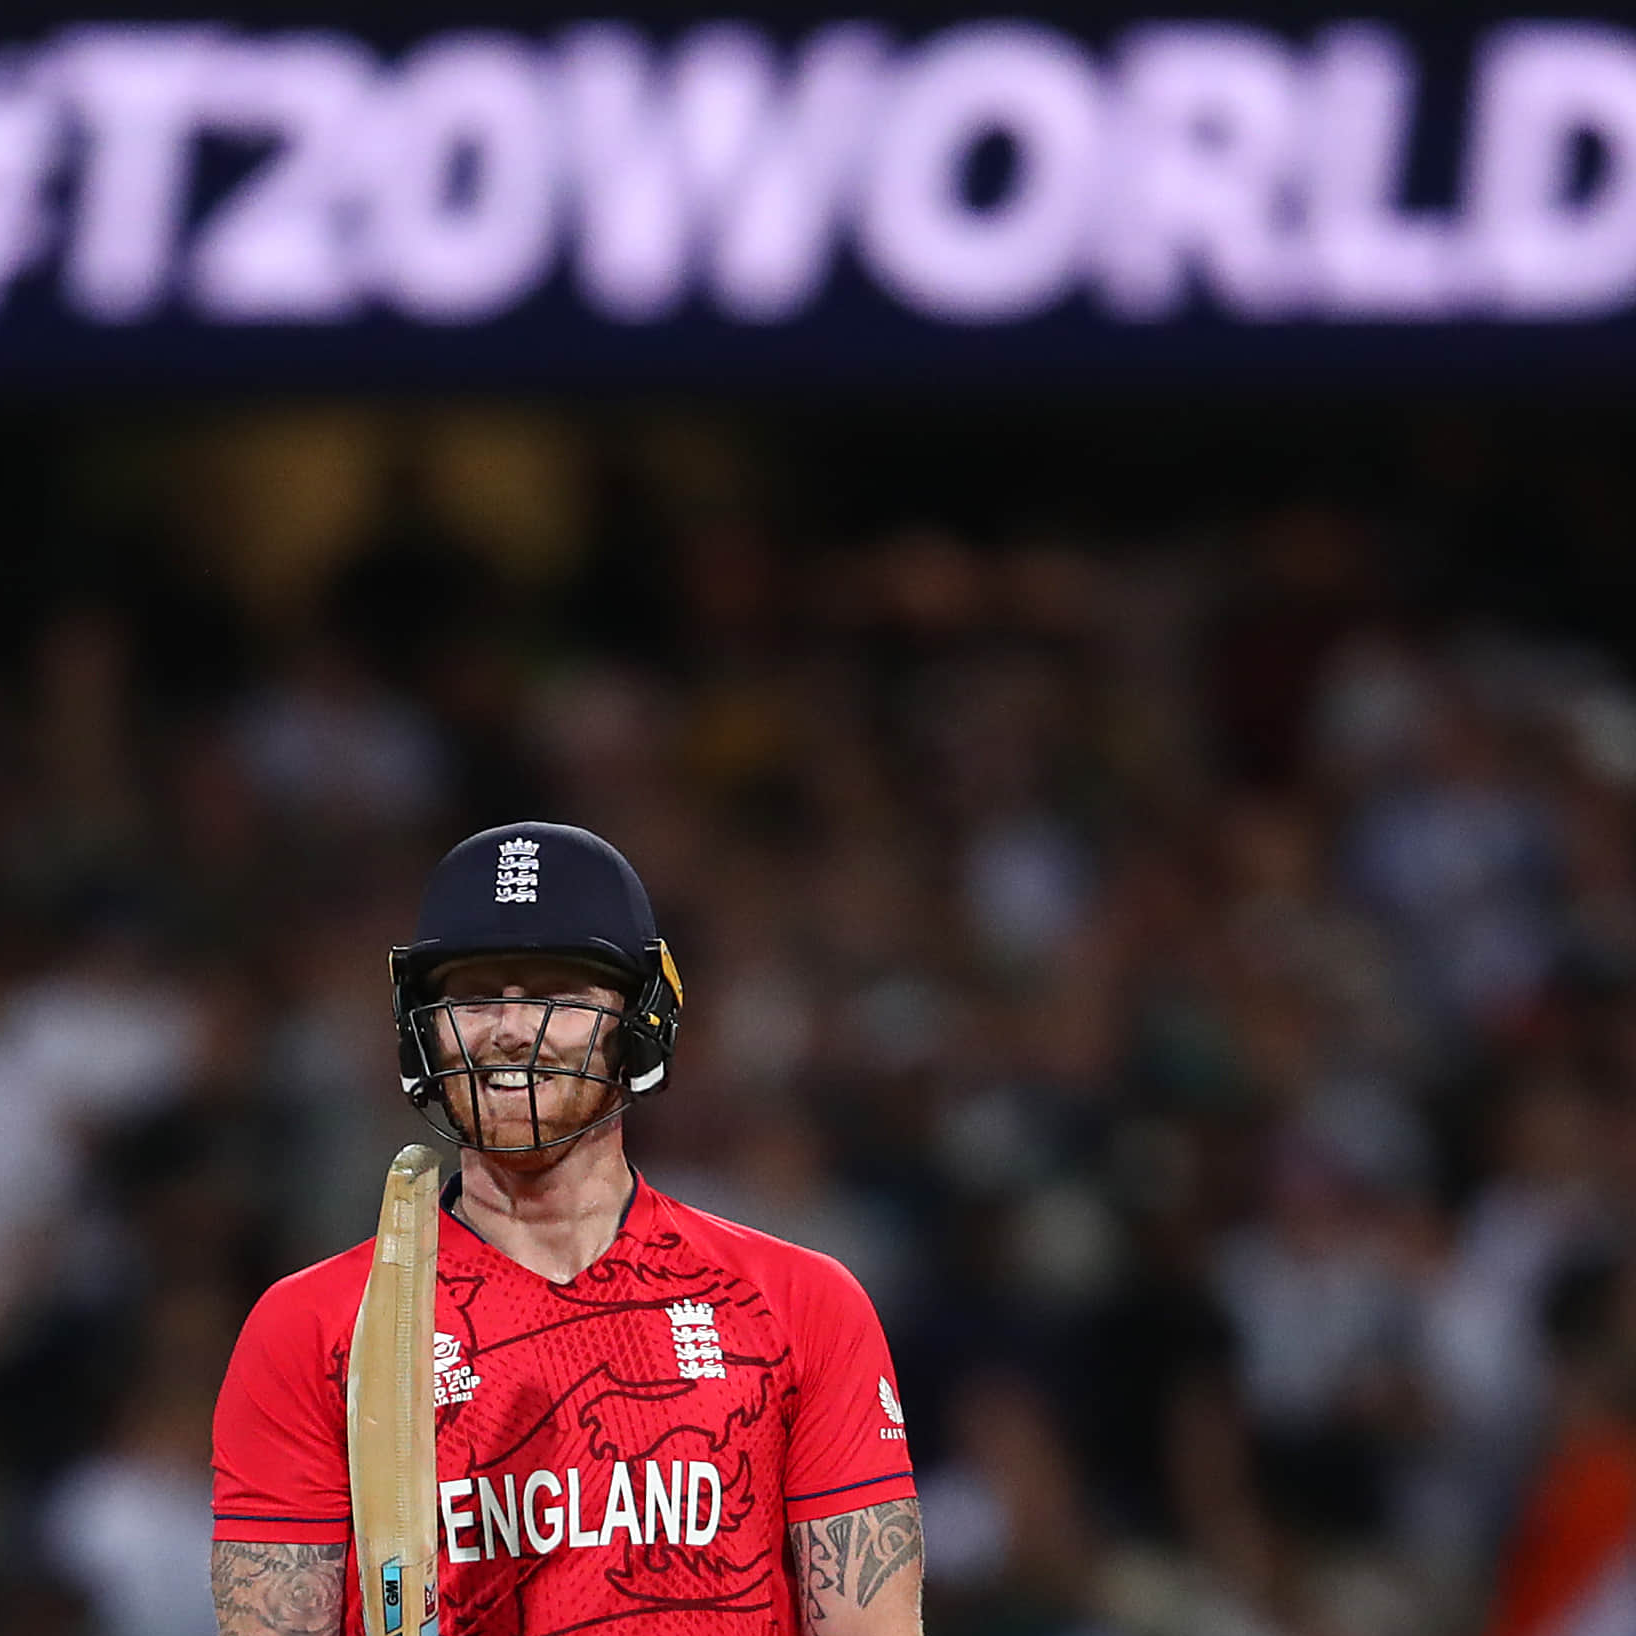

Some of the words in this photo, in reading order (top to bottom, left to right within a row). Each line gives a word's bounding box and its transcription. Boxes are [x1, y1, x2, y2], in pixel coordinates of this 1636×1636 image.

[448, 1375, 482, 1393] CUP
[439, 1460, 722, 1563] ENGLAND
[385, 1580, 399, 1606] GM
